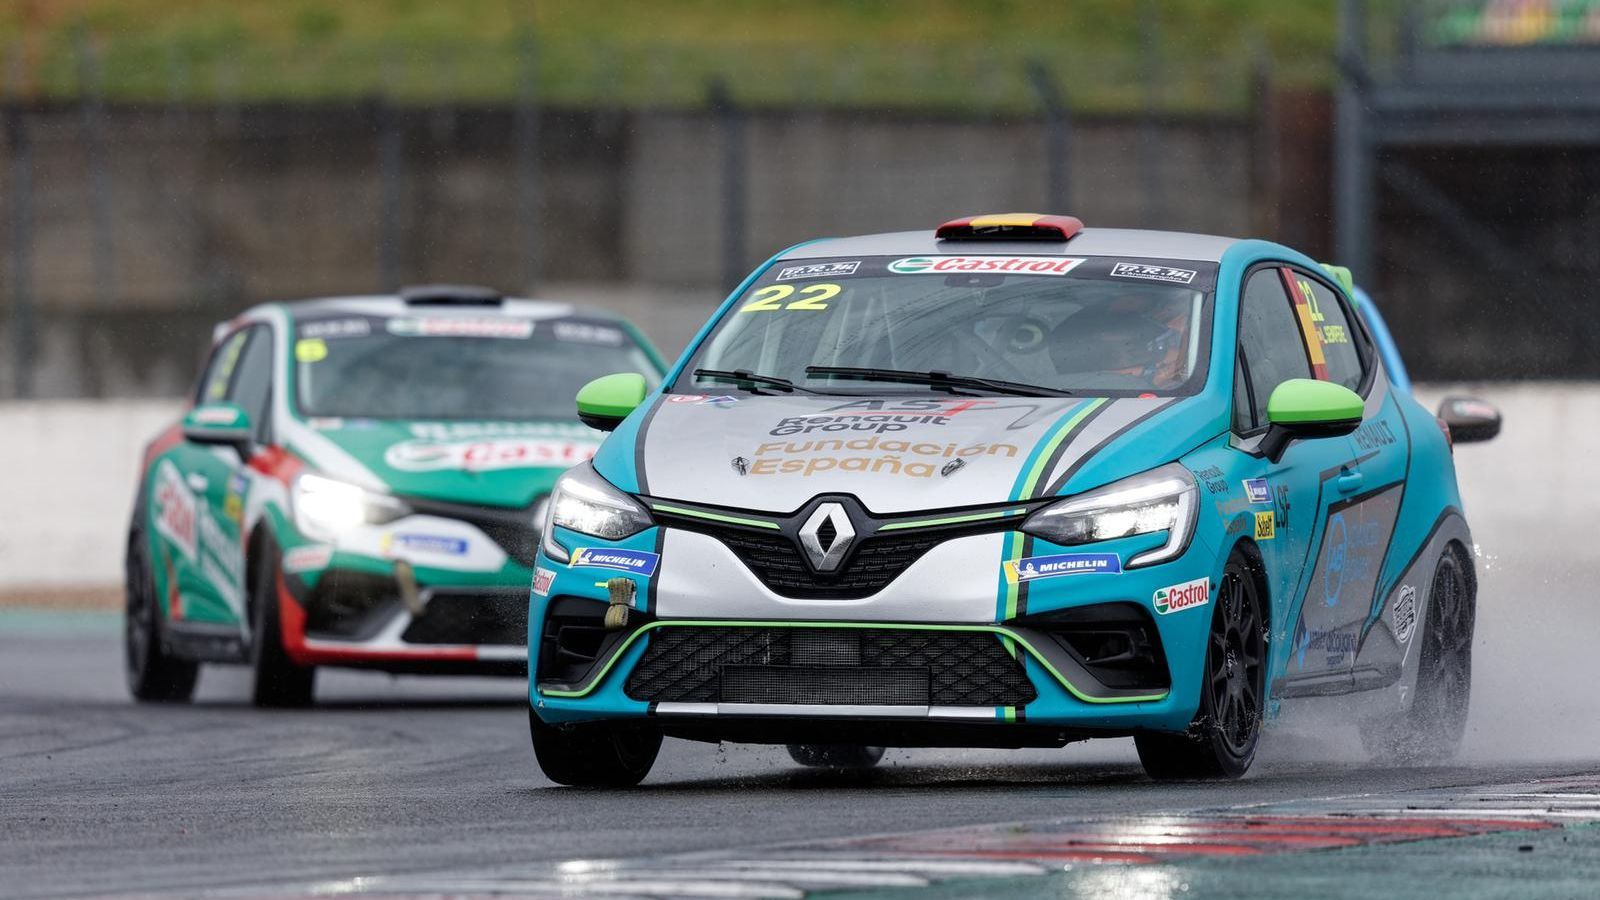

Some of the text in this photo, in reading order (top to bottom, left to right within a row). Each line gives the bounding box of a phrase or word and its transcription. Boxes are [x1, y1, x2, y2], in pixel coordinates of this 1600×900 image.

[932, 257, 1075, 273] Castrol
[740, 283, 842, 313] 22
[776, 415, 951, 426] Renault
[769, 423, 908, 436] Group
[754, 436, 1019, 458] Fundación
[750, 454, 937, 478] España
[591, 554, 647, 568] MICHELIN
[1039, 559, 1108, 572] MICHELIN
[1169, 582, 1209, 610] Castrol
